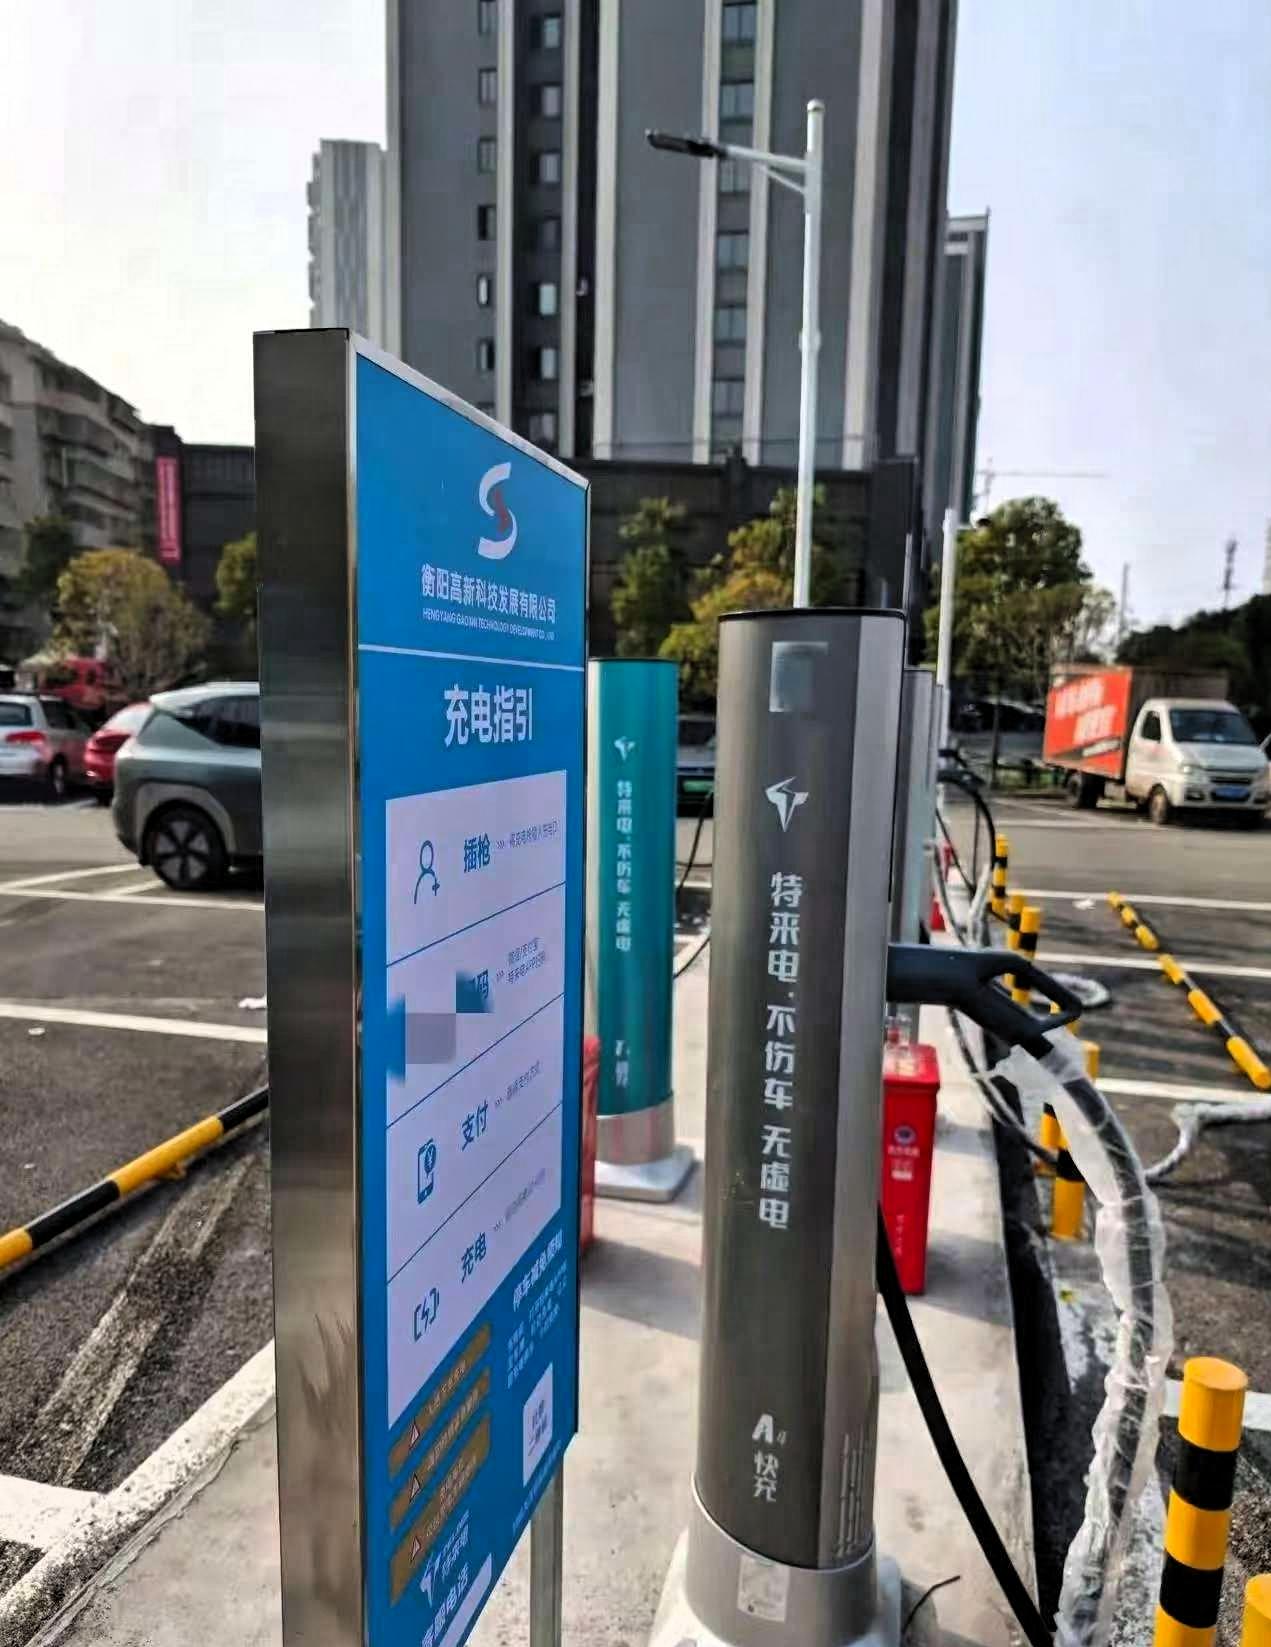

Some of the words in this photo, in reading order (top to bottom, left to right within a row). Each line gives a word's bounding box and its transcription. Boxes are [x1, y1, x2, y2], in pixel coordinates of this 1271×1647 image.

[421, 562, 557, 625] 衡阳高新科技发展有限公司
[443, 683, 534, 748] 充电指引
[463, 833, 492, 873] 插枪
[461, 1099, 489, 1151] 支付
[758, 1124, 792, 1231] 无虚电
[460, 1231, 487, 1284] 充电
